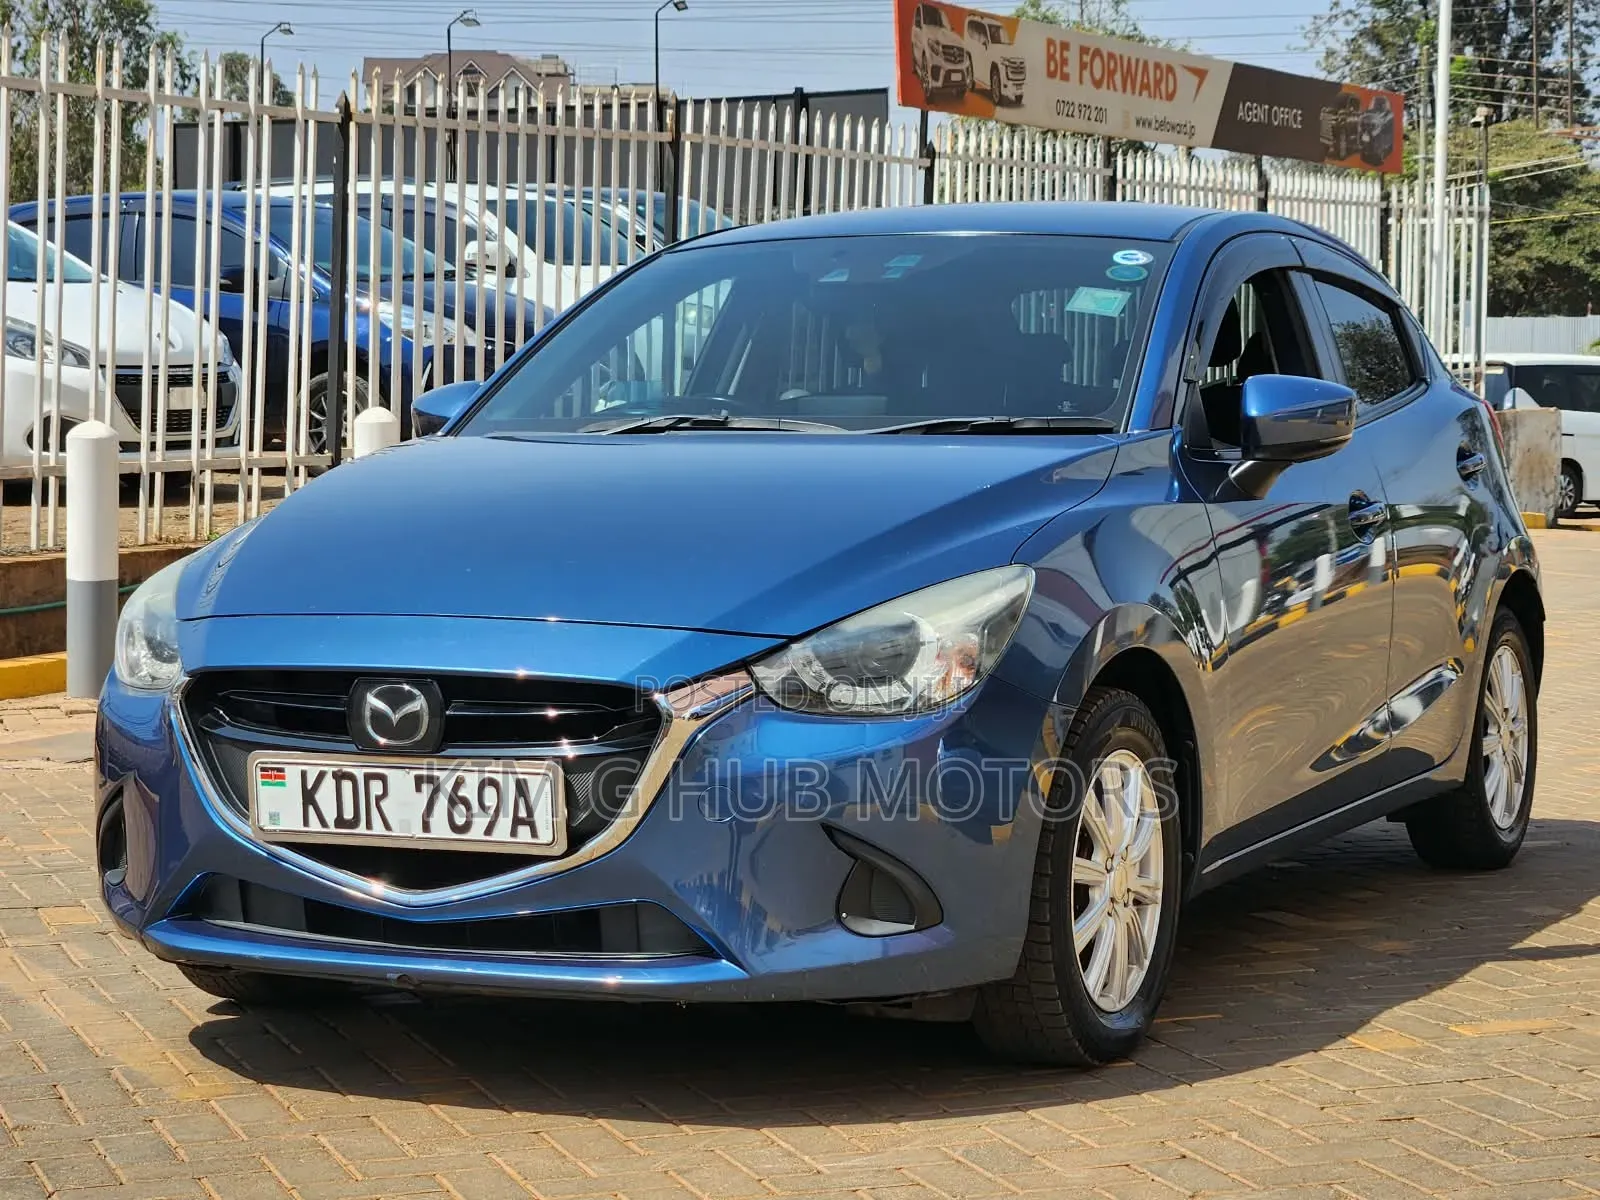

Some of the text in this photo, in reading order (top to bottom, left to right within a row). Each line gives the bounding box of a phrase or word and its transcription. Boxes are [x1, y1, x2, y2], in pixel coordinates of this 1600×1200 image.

[1046, 38, 1177, 102] BE FORWARD
[1055, 99, 1108, 125] 0722 972 201
[1237, 101, 1302, 128] AGENT OFFICE
[301, 769, 393, 832] KDR
[413, 773, 541, 839] 769A
